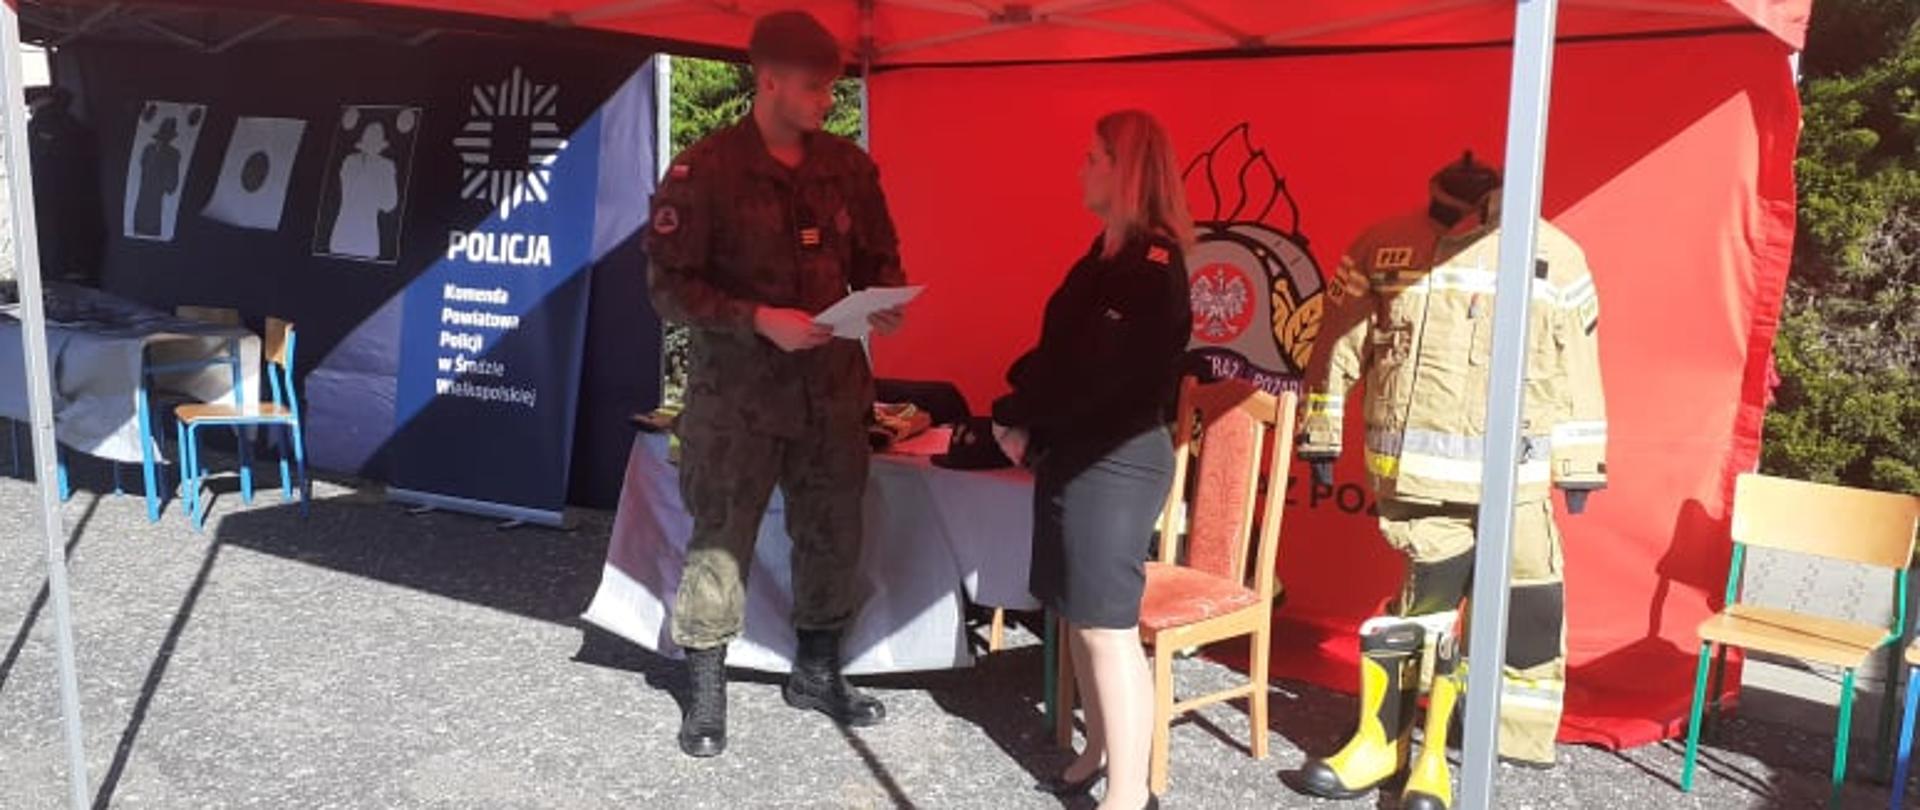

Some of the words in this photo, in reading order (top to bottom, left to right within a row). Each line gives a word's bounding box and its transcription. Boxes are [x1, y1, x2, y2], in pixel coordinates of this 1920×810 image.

[447, 231, 552, 266] POLICJA
[443, 284, 509, 305] Komenda
[441, 307, 520, 329] Powiatowa
[439, 331, 483, 353] Policji
[437, 358, 453, 372] w
